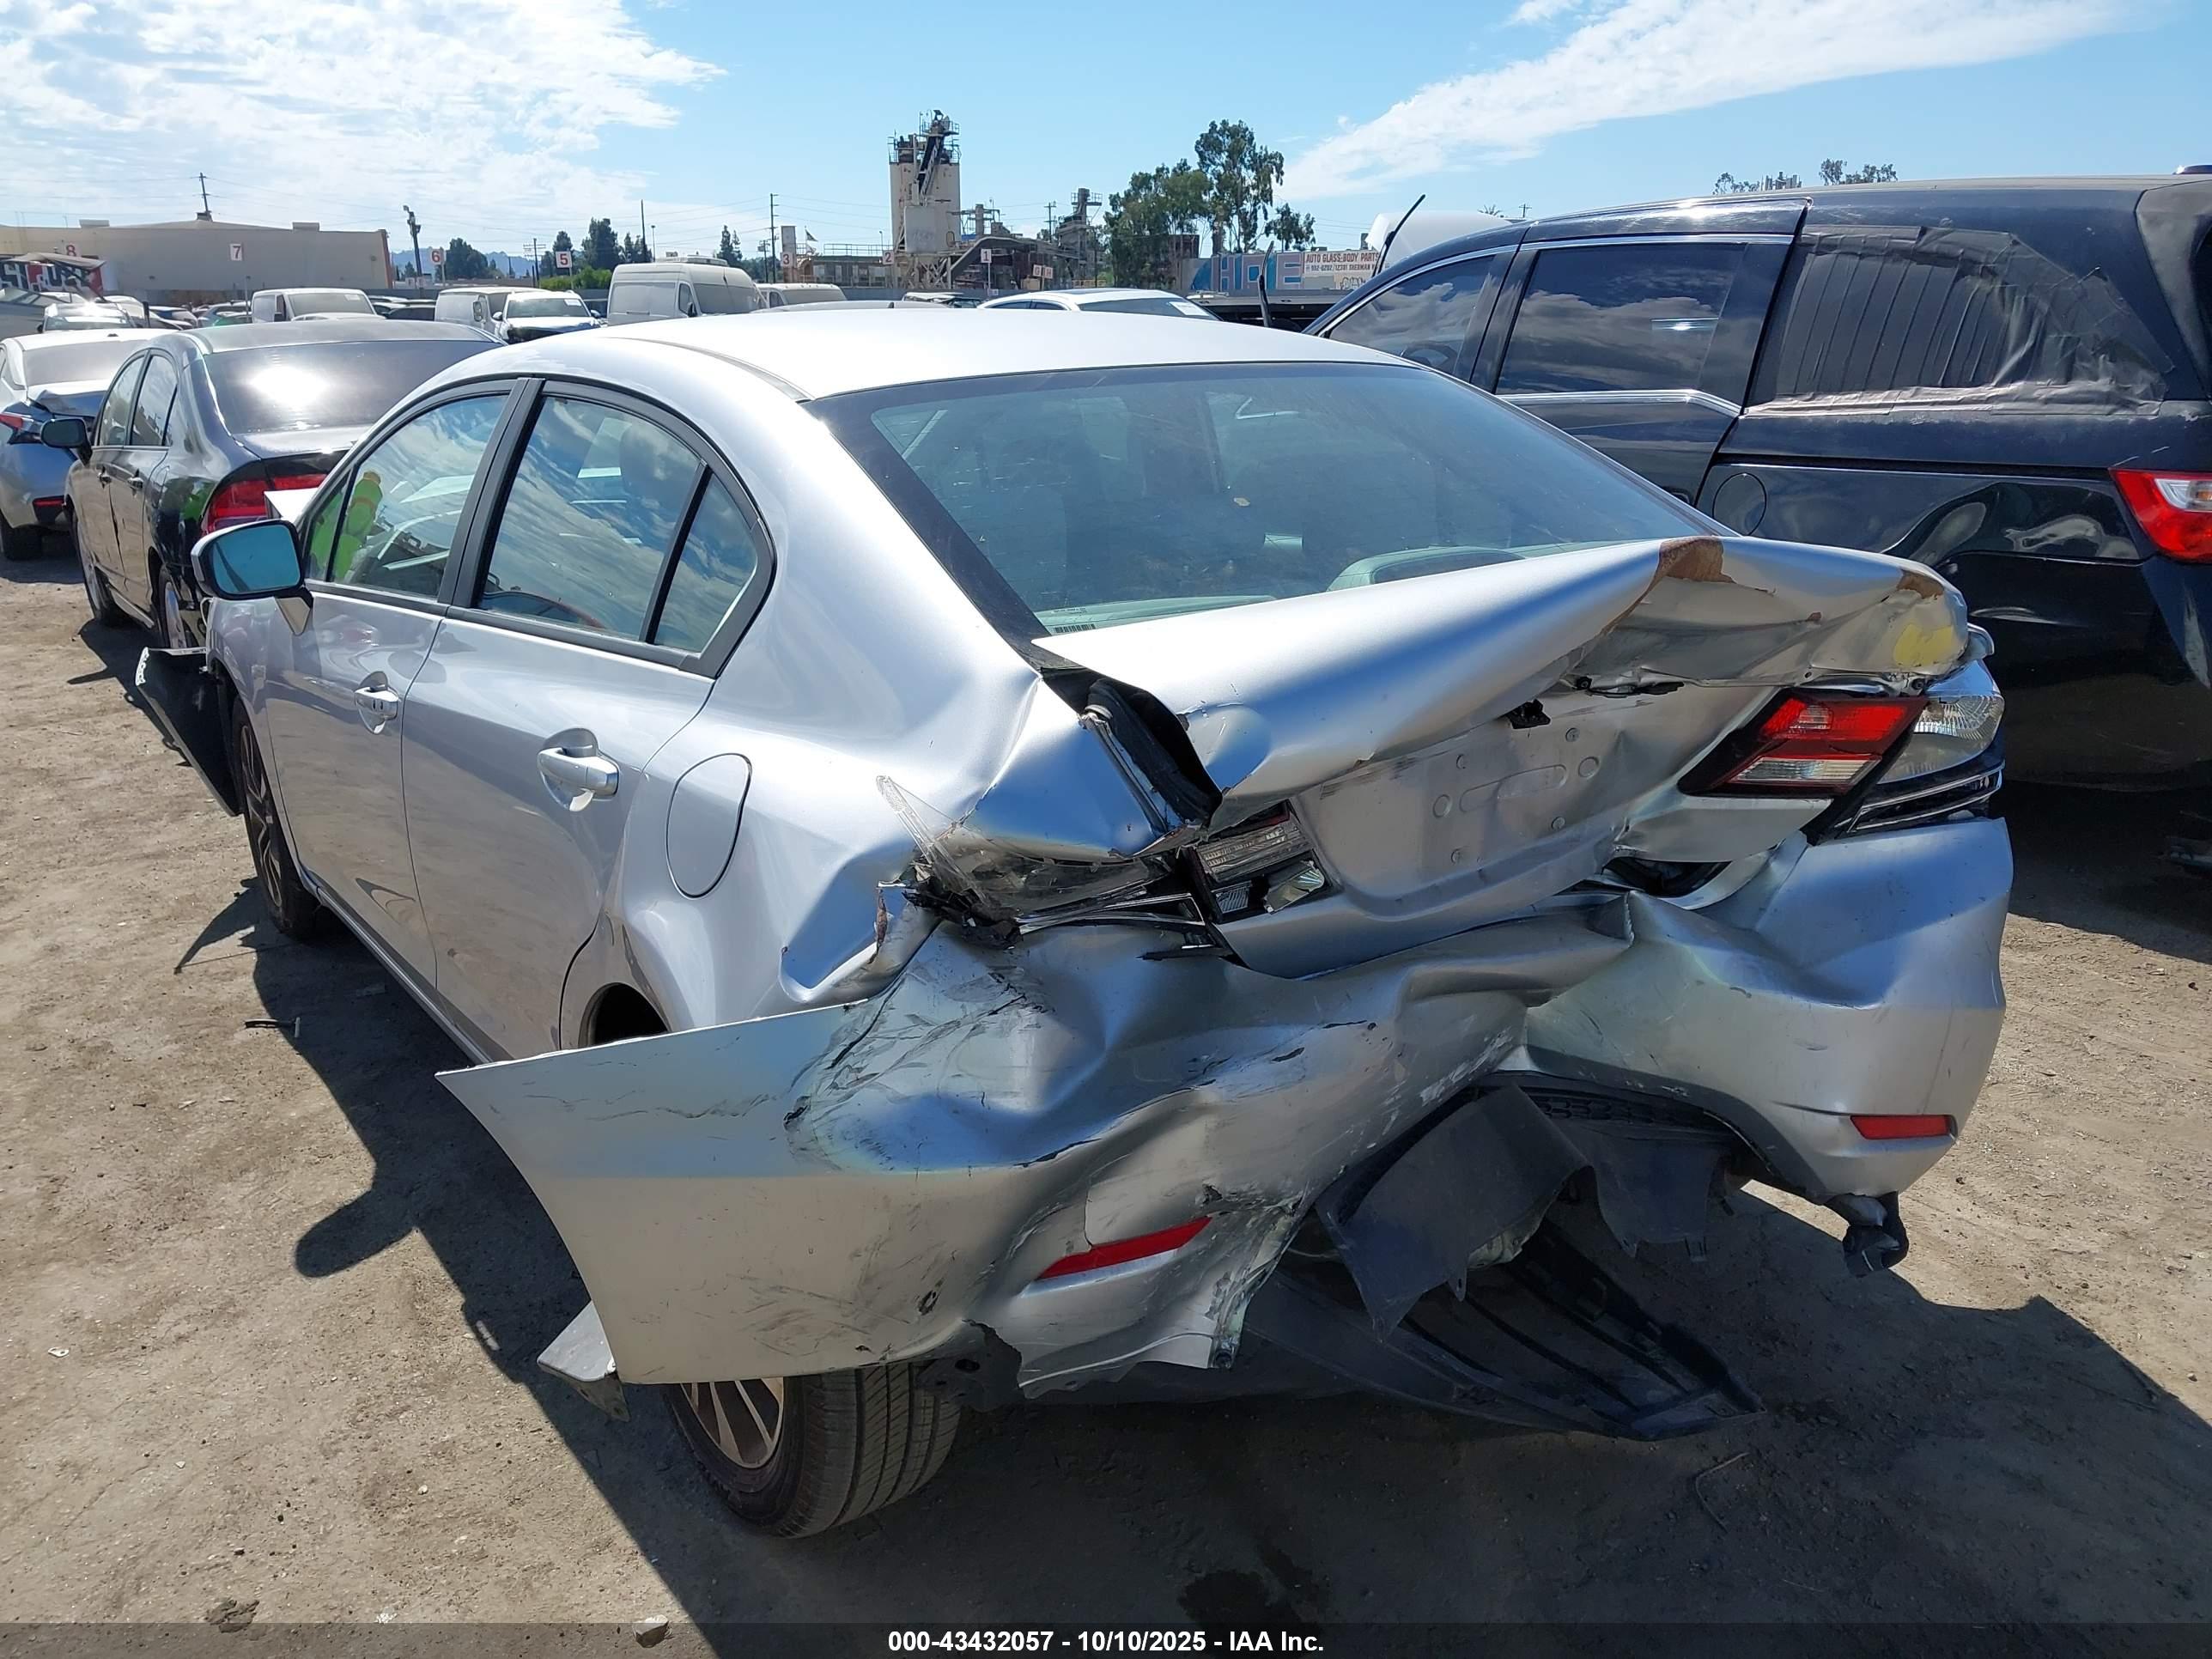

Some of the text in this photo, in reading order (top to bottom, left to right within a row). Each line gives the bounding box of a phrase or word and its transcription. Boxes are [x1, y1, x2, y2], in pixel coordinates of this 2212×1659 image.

[66, 245, 76, 257] 8
[233, 246, 241, 258] 7
[431, 250, 441, 263] 6
[982, 250, 989, 261] 1
[560, 253, 568, 265] 5
[782, 253, 790, 264] 3
[884, 252, 892, 262] 2
[1306, 253, 1321, 263] AUTO
[1361, 252, 1379, 262] PARTS
